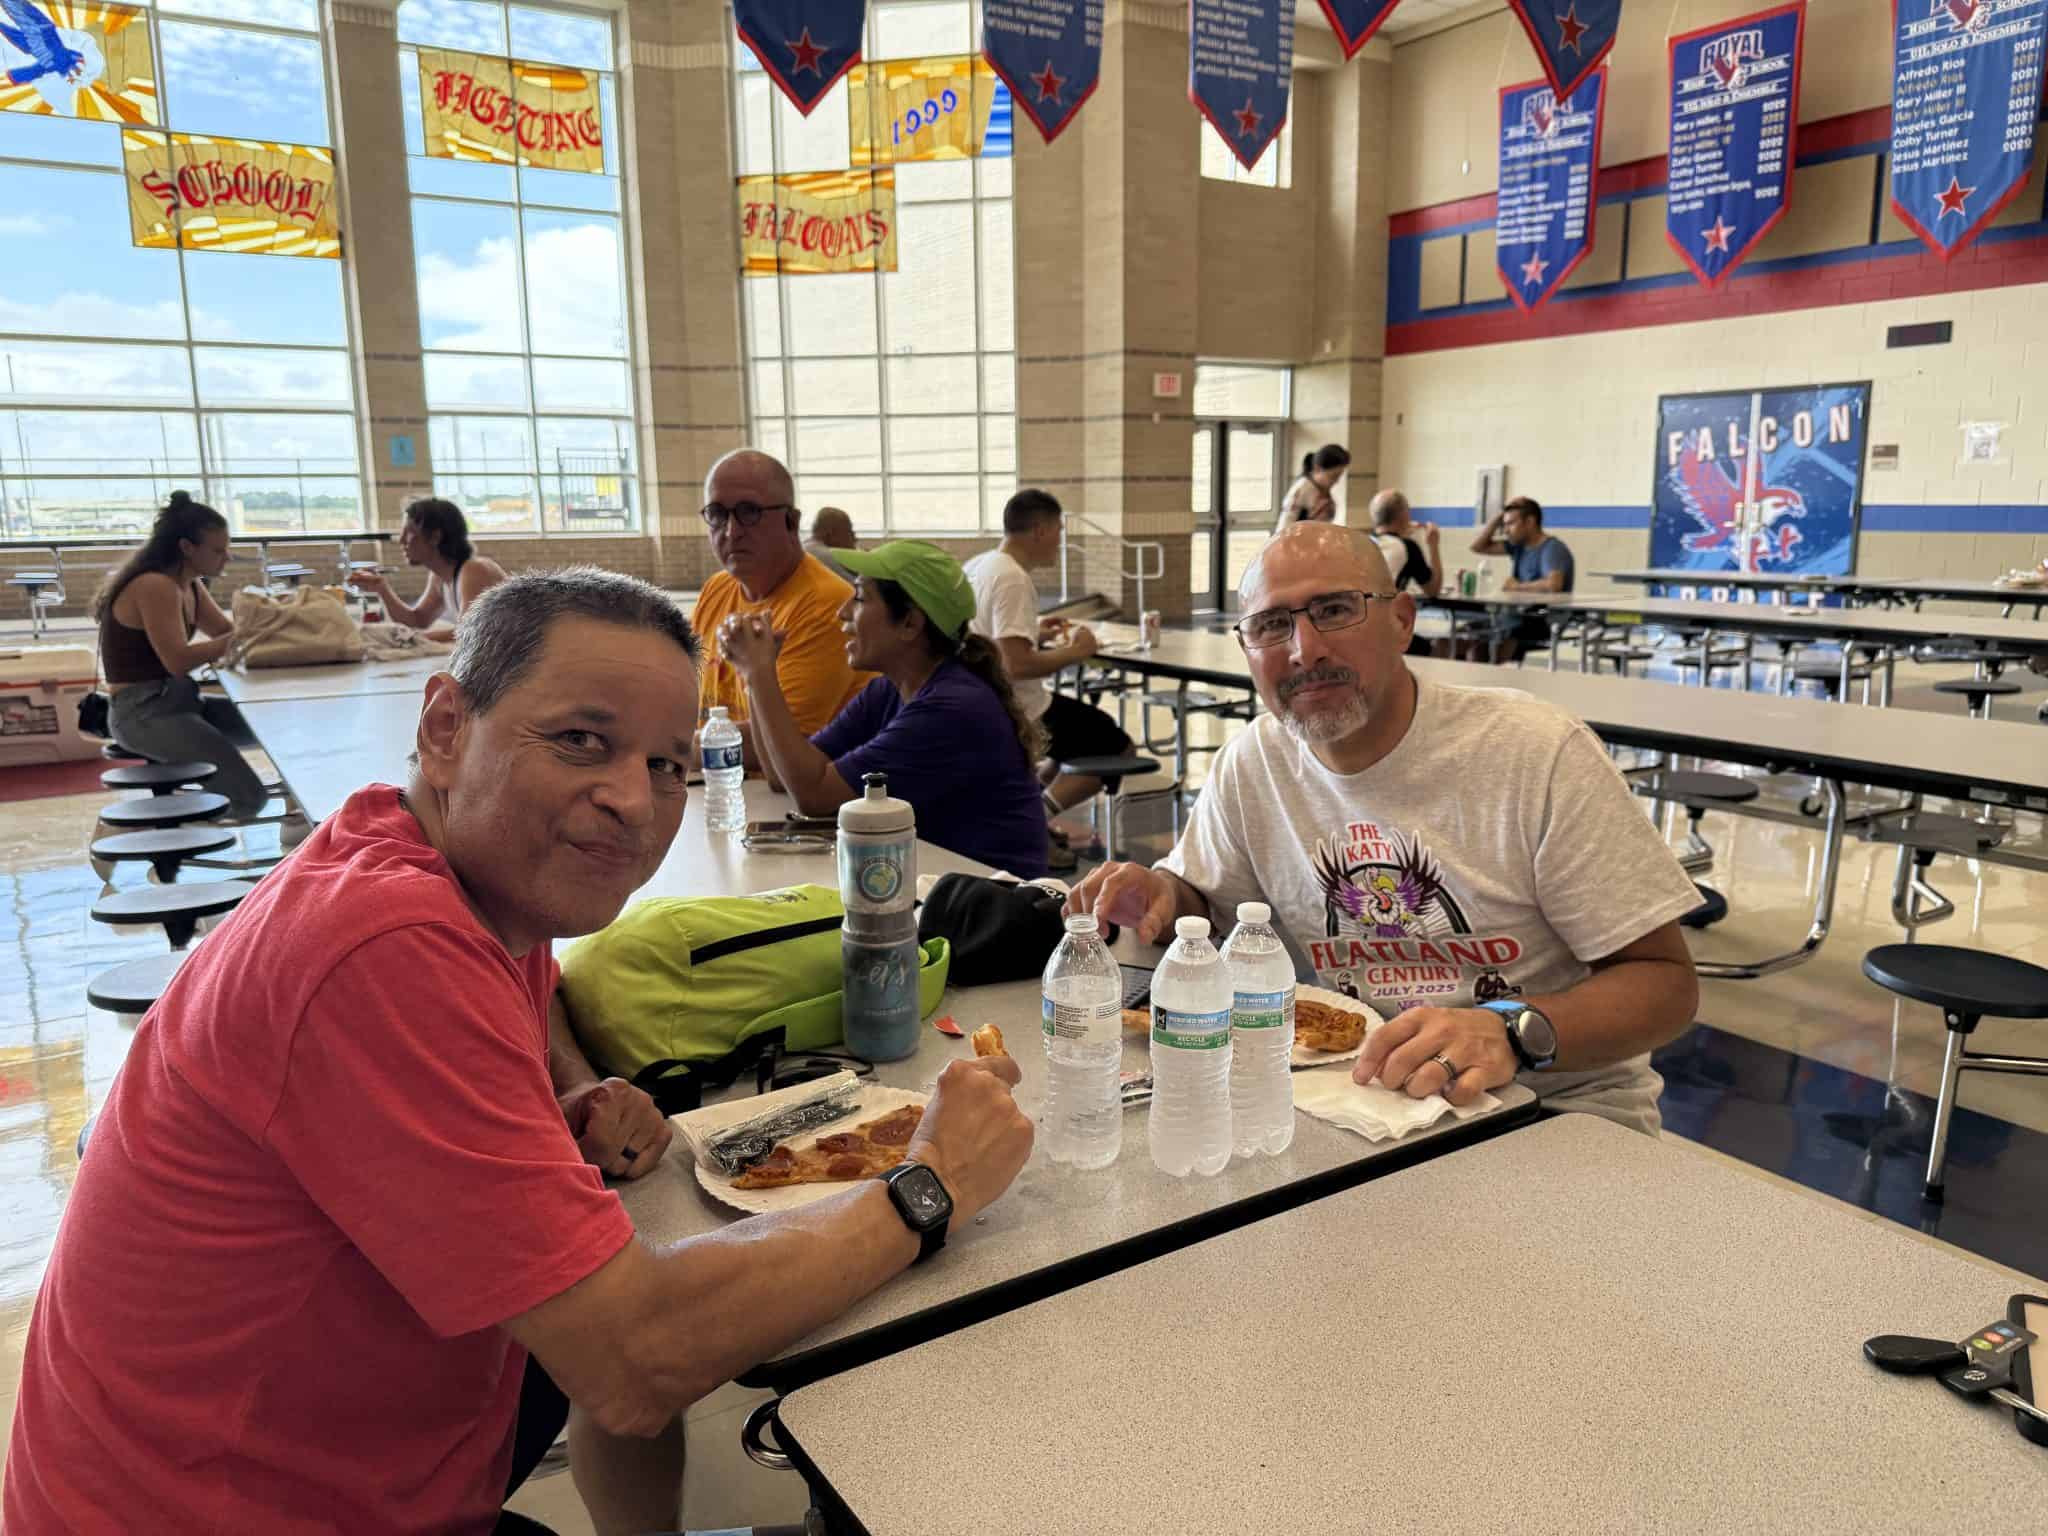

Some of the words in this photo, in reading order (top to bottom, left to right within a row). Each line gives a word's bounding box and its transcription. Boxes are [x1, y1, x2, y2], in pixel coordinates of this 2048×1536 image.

[1700, 29, 1765, 73] ROYAL
[1897, 64, 1939, 82] Alfredo
[1942, 58, 1965, 72] Rios
[2014, 37, 2041, 53] 2021
[1896, 95, 1921, 110] Gary
[1924, 88, 1954, 102] Miller
[2011, 66, 2038, 81] 2021
[1893, 135, 1922, 150] Colby
[1926, 127, 1959, 142] Turner
[2007, 109, 2034, 125] 2021
[1895, 118, 1936, 137] Angeles
[1939, 111, 1975, 126] Garcia
[2008, 96, 2036, 110] 2021
[1892, 149, 1920, 163] Jesus
[1923, 138, 1969, 156] Martinez
[2005, 124, 2033, 139] 2021
[1892, 161, 1920, 175] Jesus
[1921, 151, 1969, 169] Martinez
[141, 160, 324, 221] SCHOOL
[743, 202, 889, 257] FALCONS
[1667, 403, 1850, 466] FALCON
[1346, 843, 1393, 863] KATY
[1348, 824, 1383, 842] THE
[1309, 938, 1521, 971] FLATLAND
[1367, 967, 1460, 985] CENTURY
[1373, 984, 1412, 998] JULY
